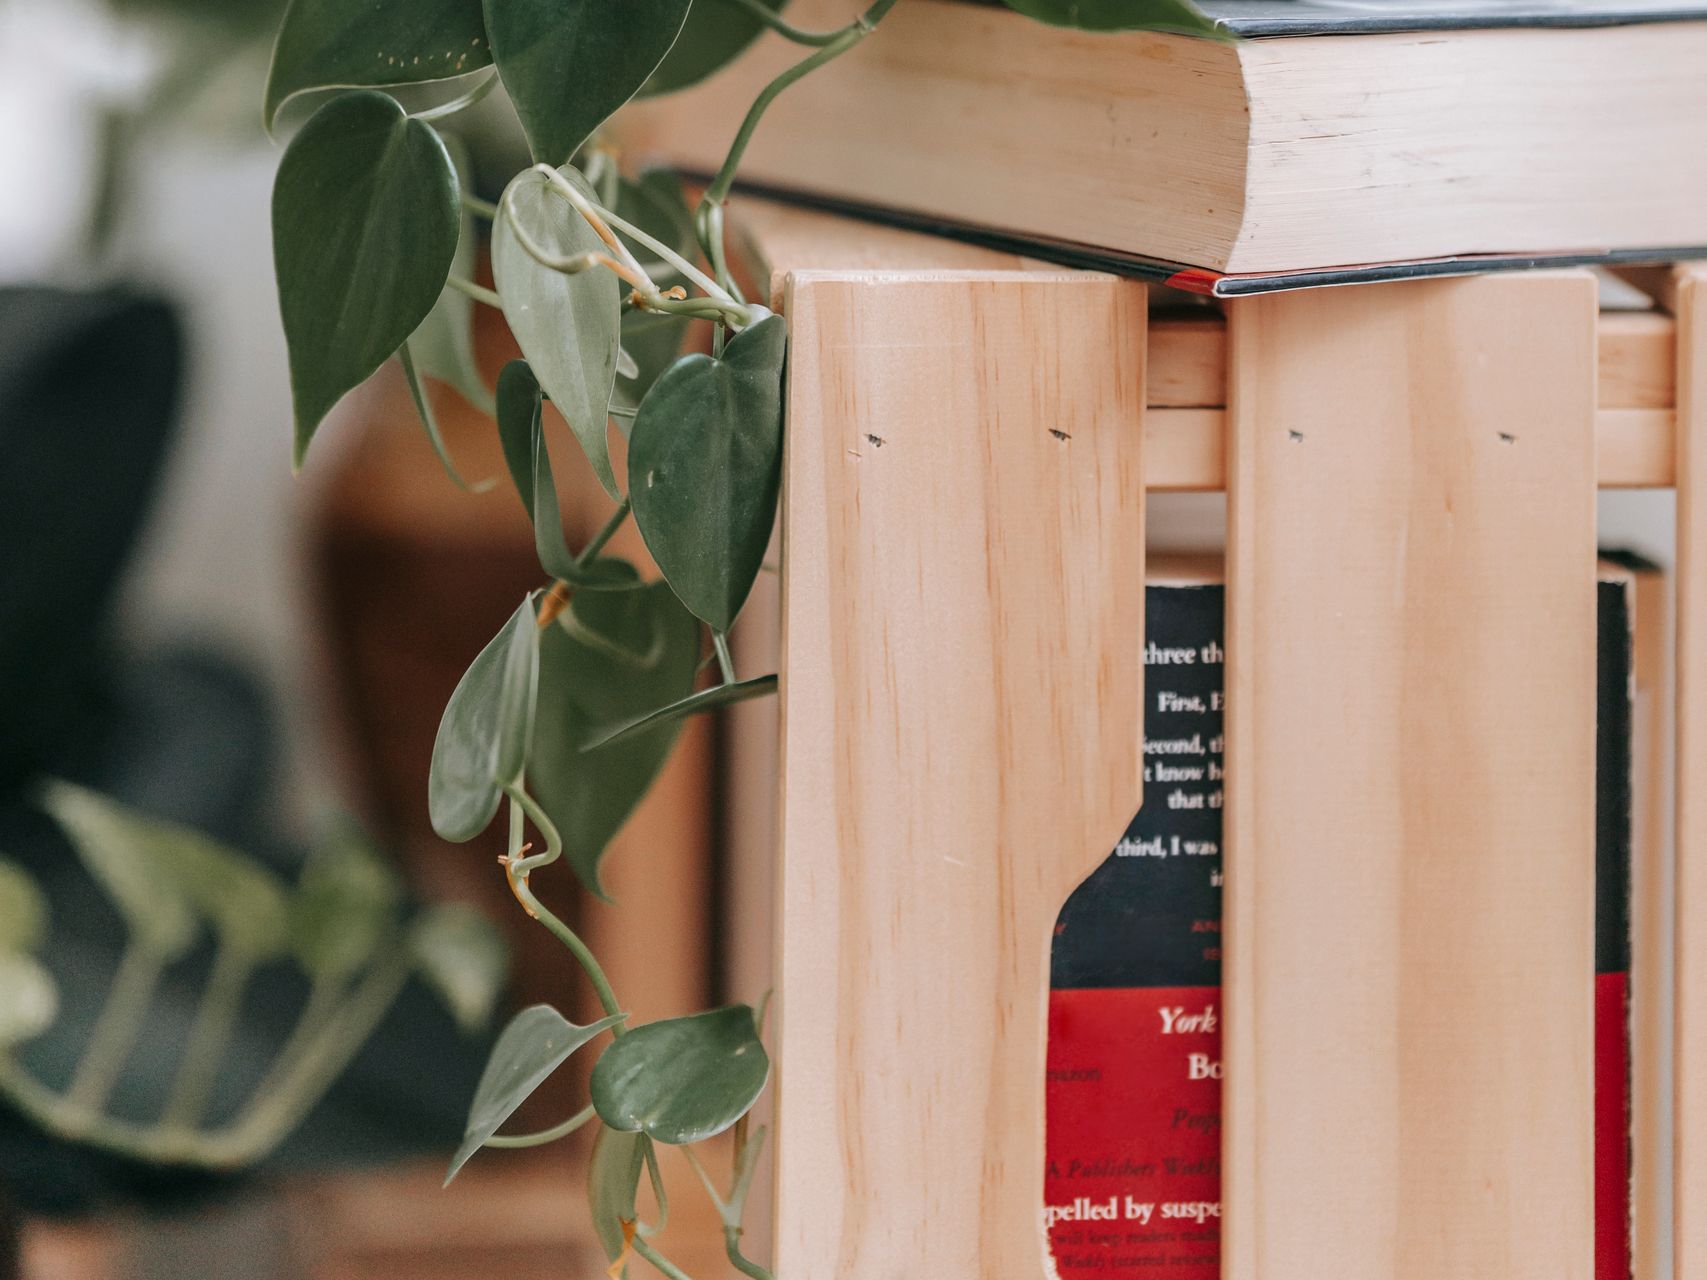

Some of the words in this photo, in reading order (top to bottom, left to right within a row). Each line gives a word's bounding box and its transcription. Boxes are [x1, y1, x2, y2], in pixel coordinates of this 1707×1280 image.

[1143, 641, 1196, 665] three
[1158, 691, 1206, 715] First,
[1155, 761, 1204, 782] know
[1167, 788, 1204, 809] that
[1115, 836, 1167, 859] third,
[1170, 836, 1180, 856] I
[1182, 841, 1218, 855] was
[1157, 1005, 1217, 1034] York
[1043, 1195, 1118, 1227] pelled
[1124, 1195, 1155, 1225] by
